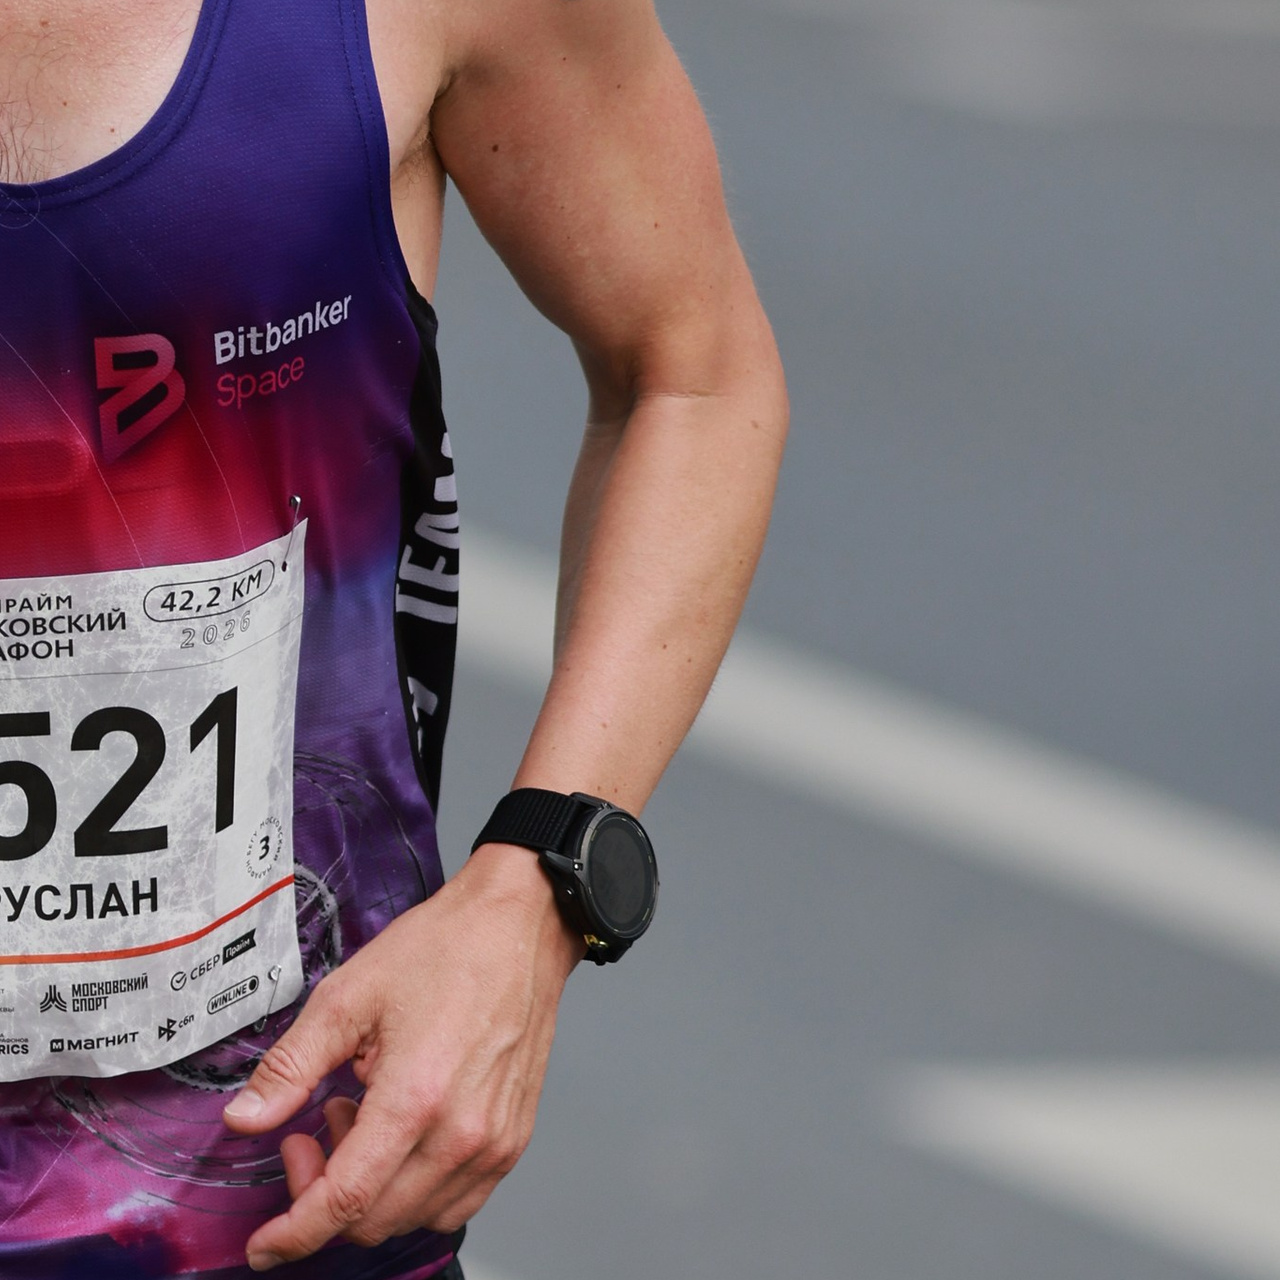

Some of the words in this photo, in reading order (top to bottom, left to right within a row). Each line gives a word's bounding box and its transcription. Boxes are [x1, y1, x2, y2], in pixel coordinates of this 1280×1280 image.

[214, 294, 352, 365] Bitbanker
[216, 356, 306, 410] Space
[160, 586, 221, 614] 42,2
[231, 569, 264, 602] КМ
[180, 610, 251, 649] 2026
[259, 835, 270, 860] 3
[190, 954, 221, 981] СБЕР
[225, 937, 251, 959] Прайм
[71, 972, 149, 998] МОСКОВСКИЙ
[72, 996, 109, 1012] СПОРТ
[210, 982, 248, 1011] WINLINE
